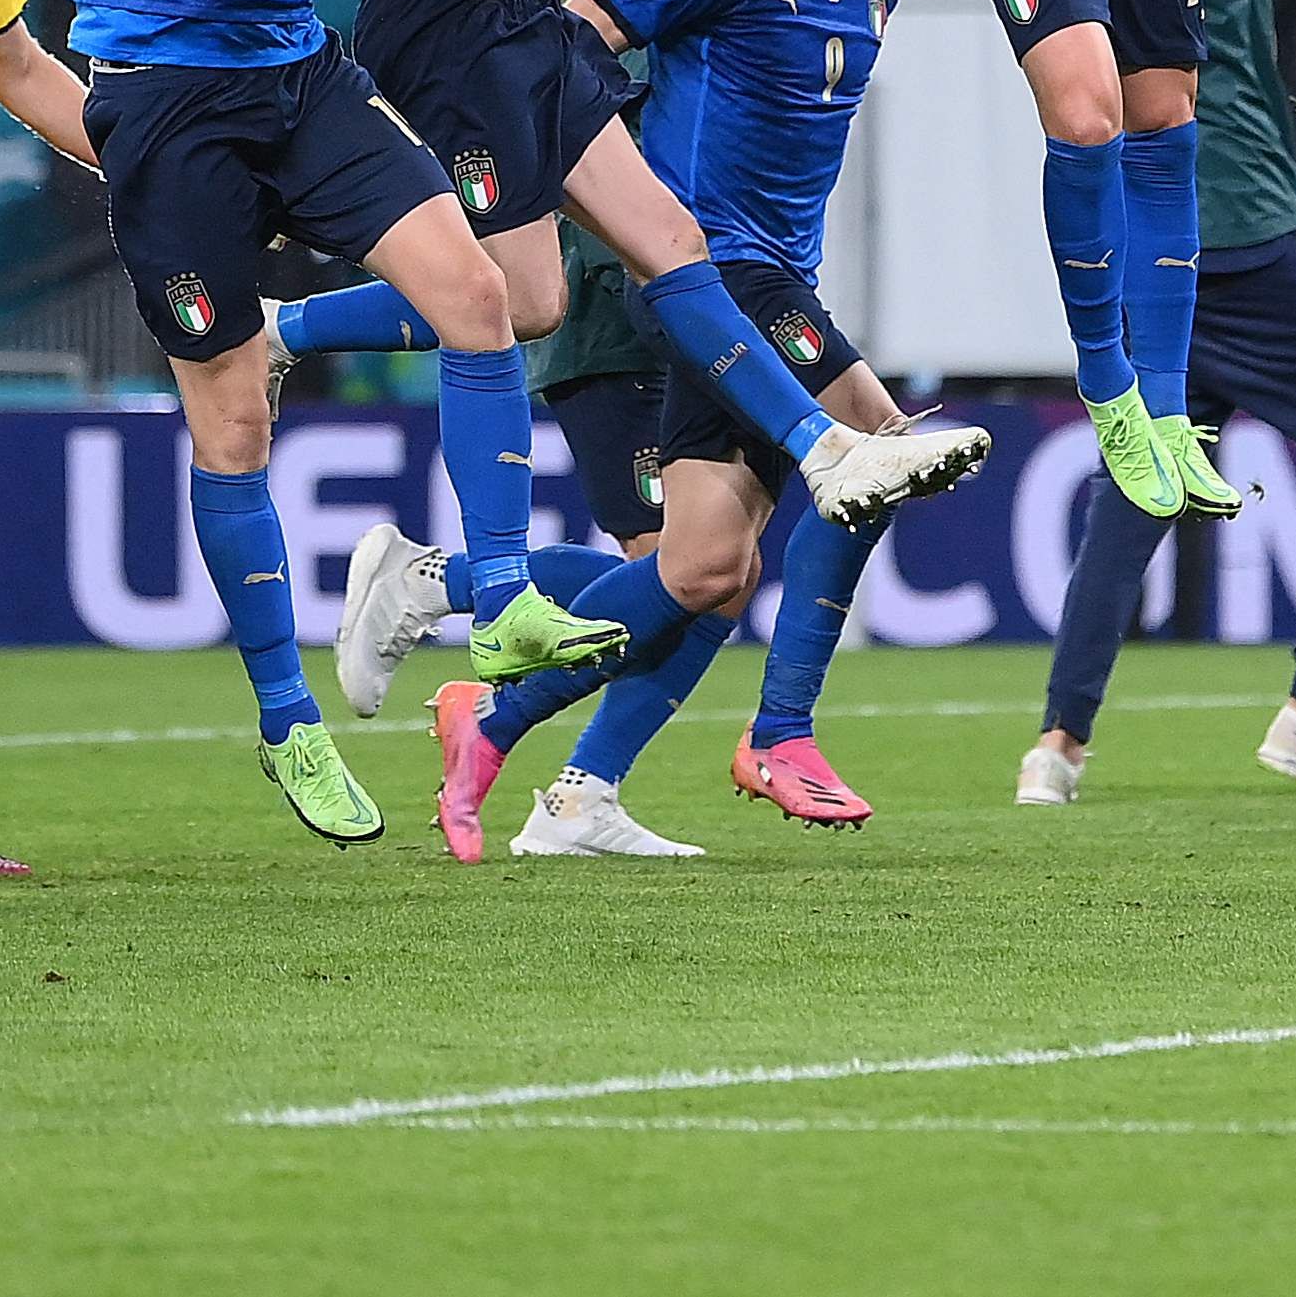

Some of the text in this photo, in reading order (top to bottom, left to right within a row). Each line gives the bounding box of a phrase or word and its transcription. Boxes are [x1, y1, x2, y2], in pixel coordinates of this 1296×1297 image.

[822, 36, 845, 103] 9
[458, 161, 490, 175] ITALIA
[171, 284, 201, 300] ITALIA
